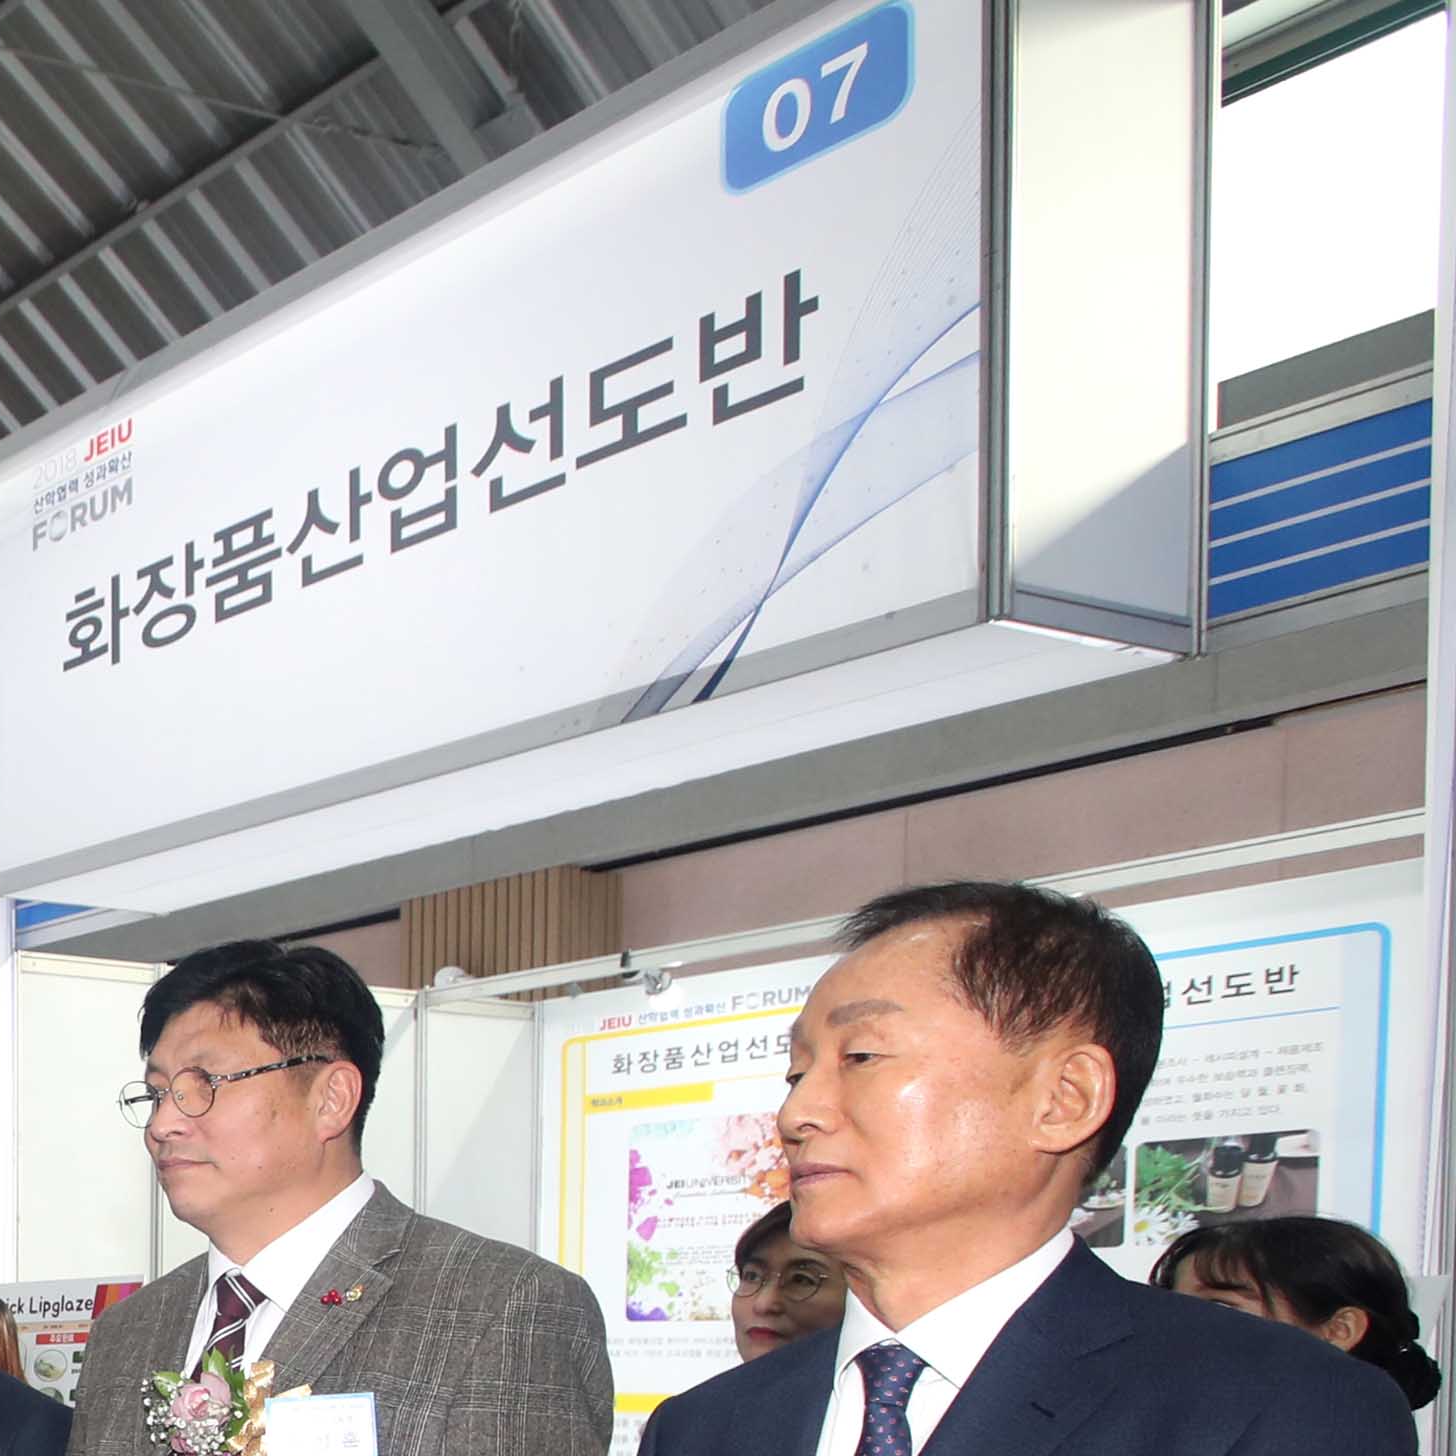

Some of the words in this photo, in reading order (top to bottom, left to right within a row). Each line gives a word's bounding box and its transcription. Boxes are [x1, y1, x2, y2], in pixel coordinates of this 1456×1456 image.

[761, 43, 869, 155] 07
[84, 418, 133, 462] JEIU
[62, 267, 820, 673] 화장품산업선도반
[32, 477, 134, 552] FORUM
[599, 1015, 632, 1031] JEIU
[28, 1294, 94, 1319] Lipglaze
